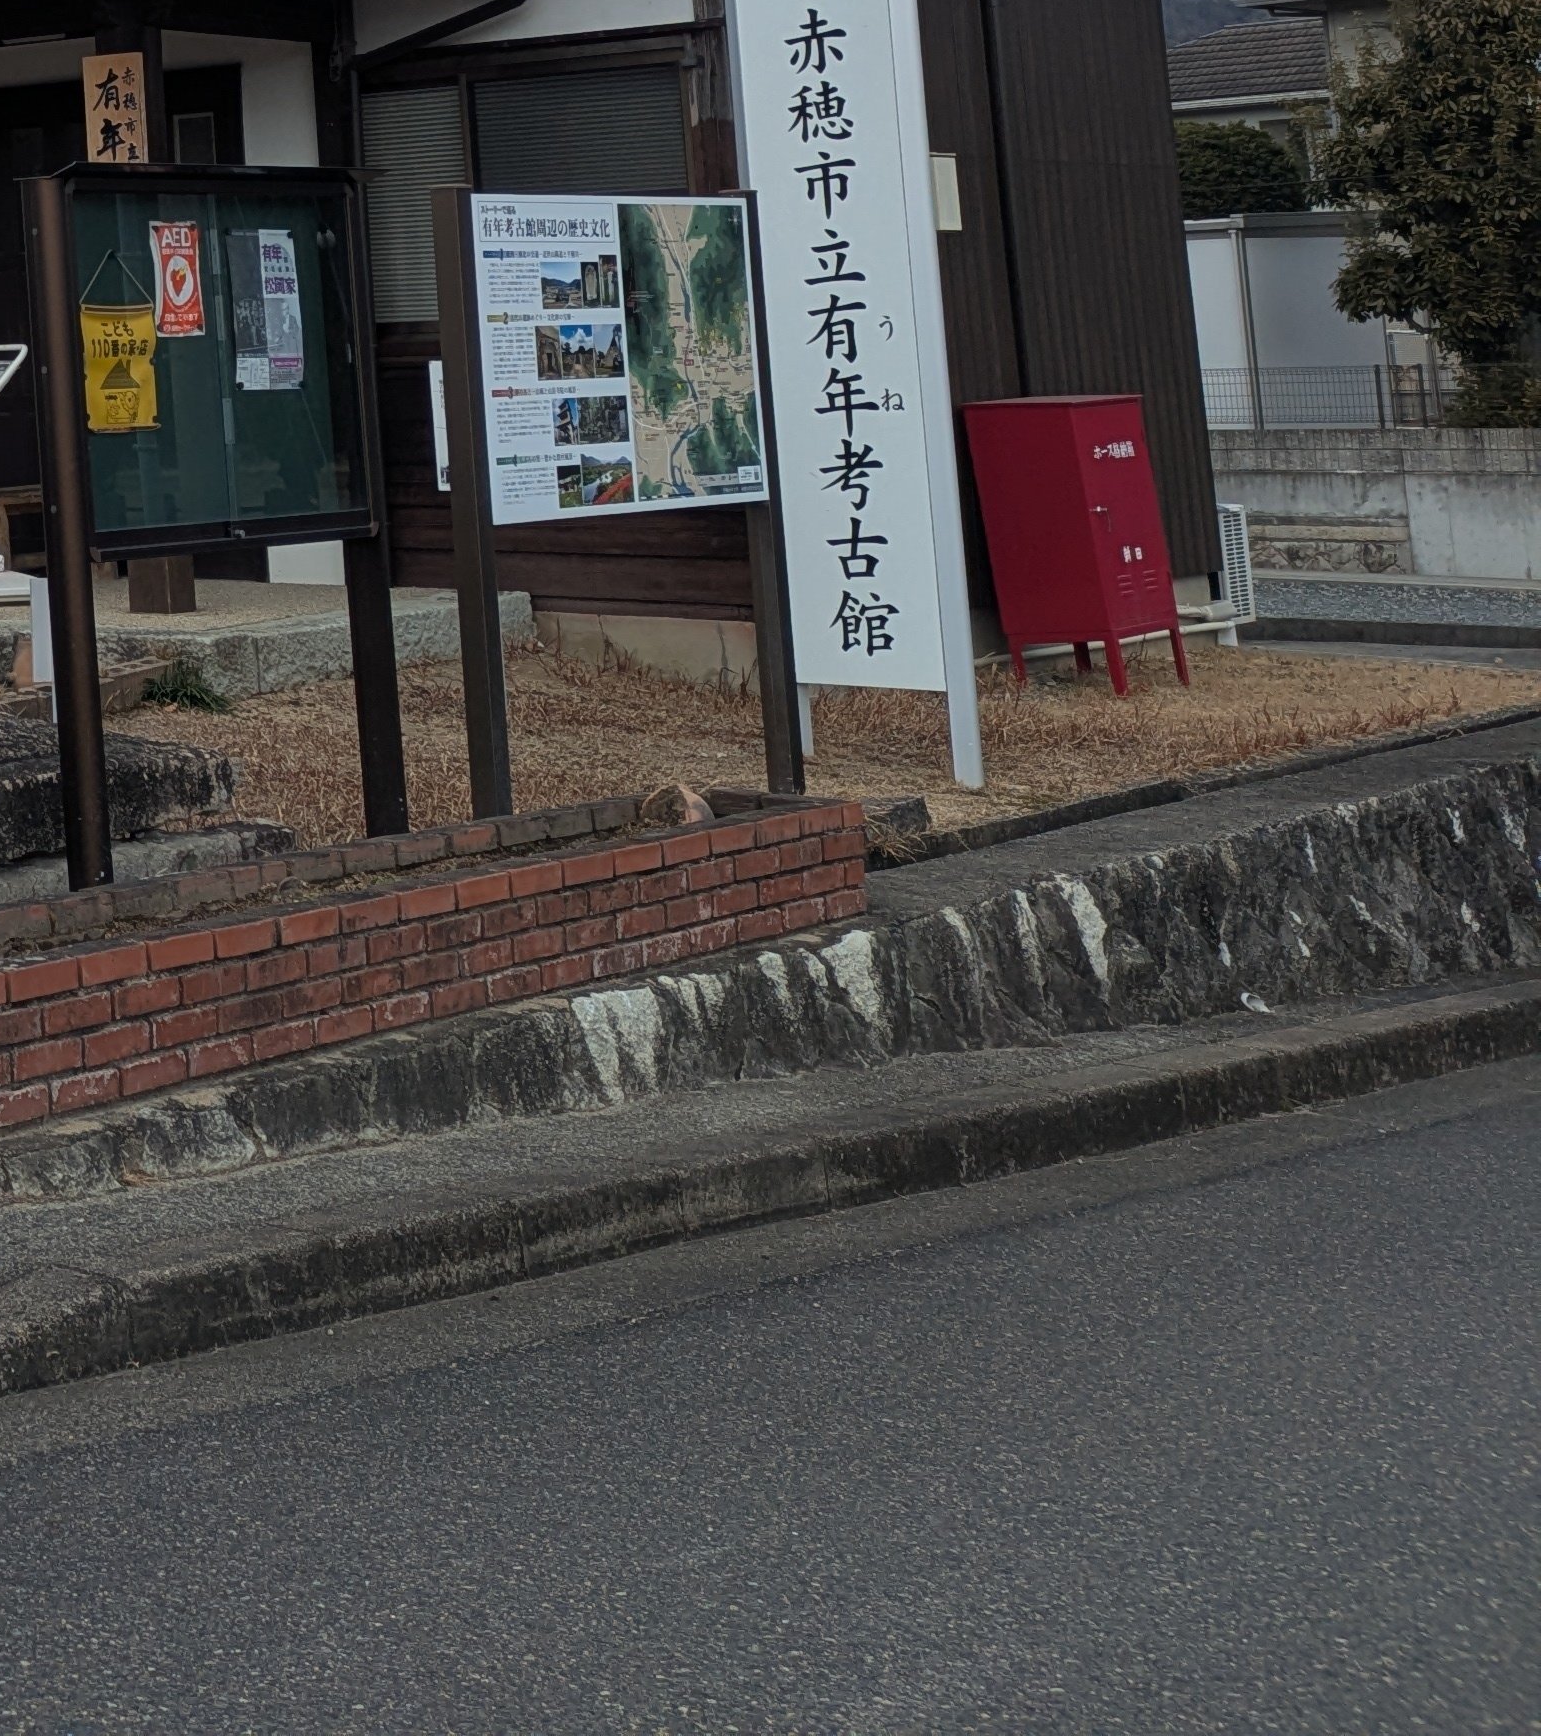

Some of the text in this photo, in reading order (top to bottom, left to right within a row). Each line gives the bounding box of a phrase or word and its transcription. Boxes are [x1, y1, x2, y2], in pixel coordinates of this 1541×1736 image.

[122, 67, 139, 160] 赤穂市立
[161, 227, 191, 247] AED
[482, 217, 611, 238] 有年考古館周辺の歴史文化
[101, 321, 134, 337] こども
[784, 8, 900, 657] 赤穂市立有年考古館
